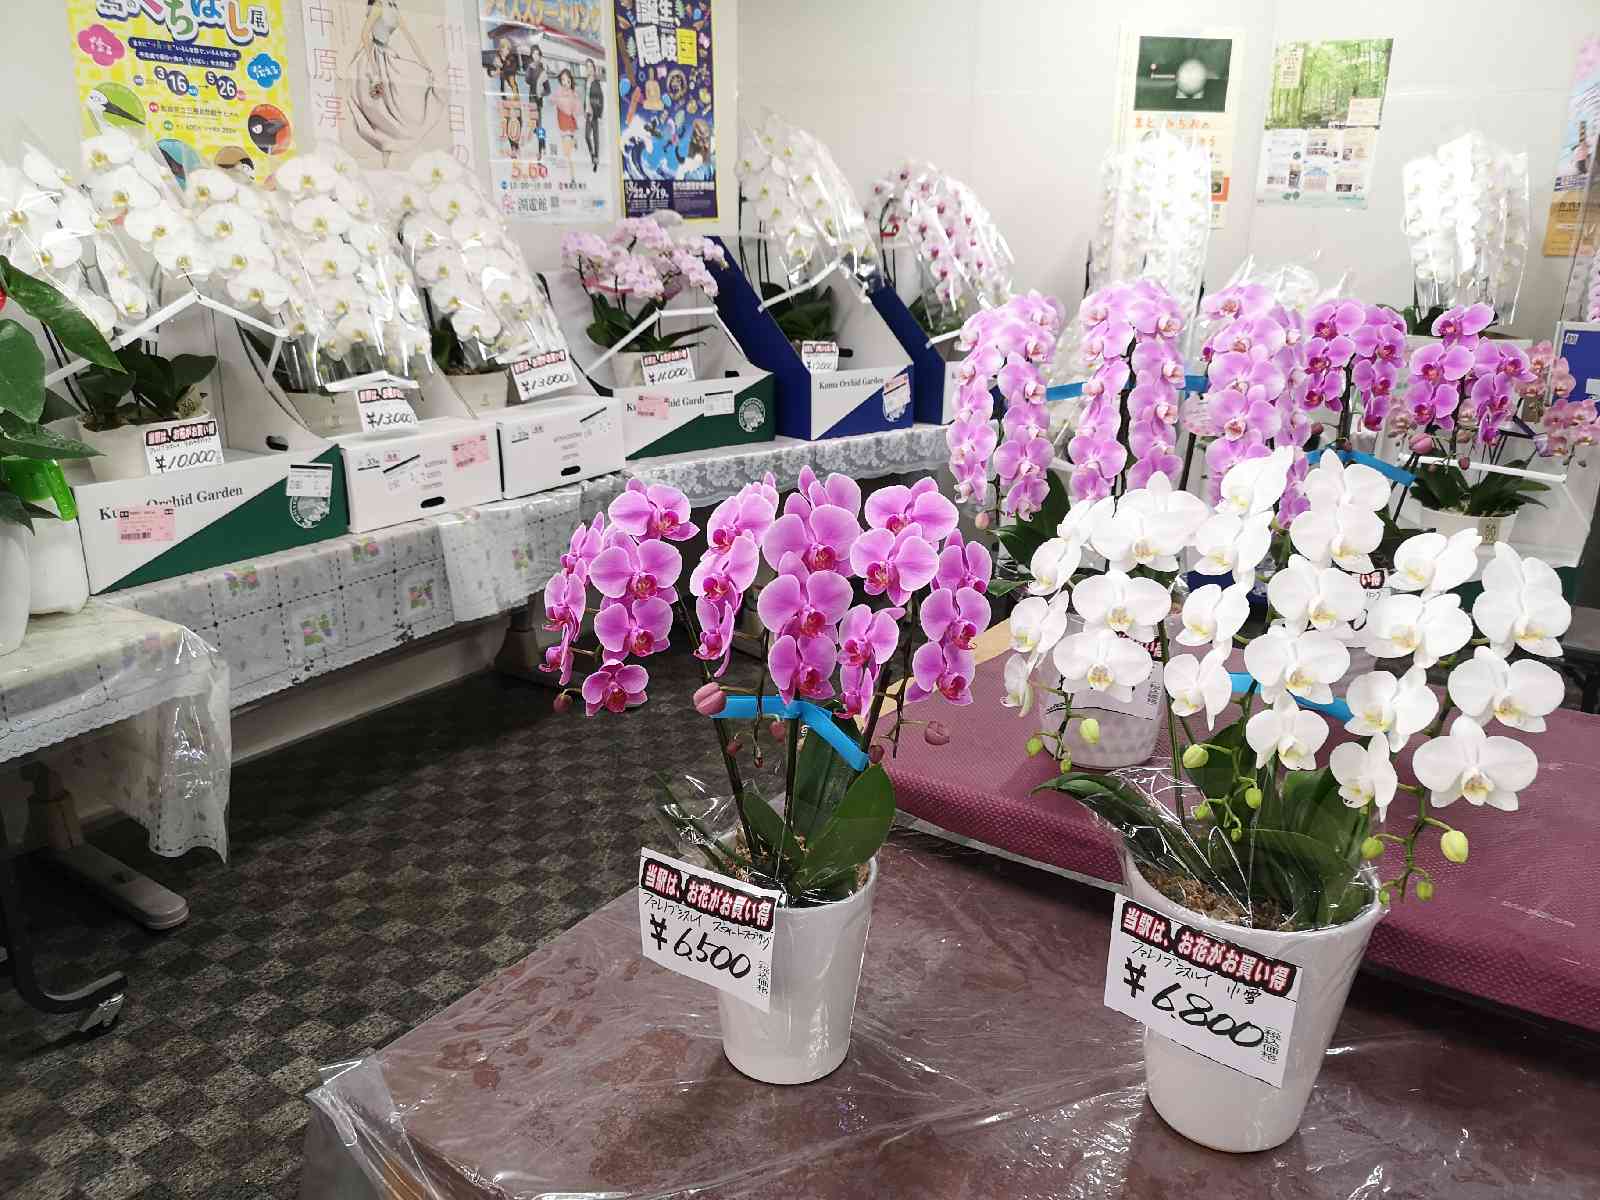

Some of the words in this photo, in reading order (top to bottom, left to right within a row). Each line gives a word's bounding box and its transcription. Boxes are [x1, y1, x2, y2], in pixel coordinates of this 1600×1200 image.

[169, 75, 187, 92] 16
[219, 80, 236, 97] 26
[196, 485, 243, 504] Garden
